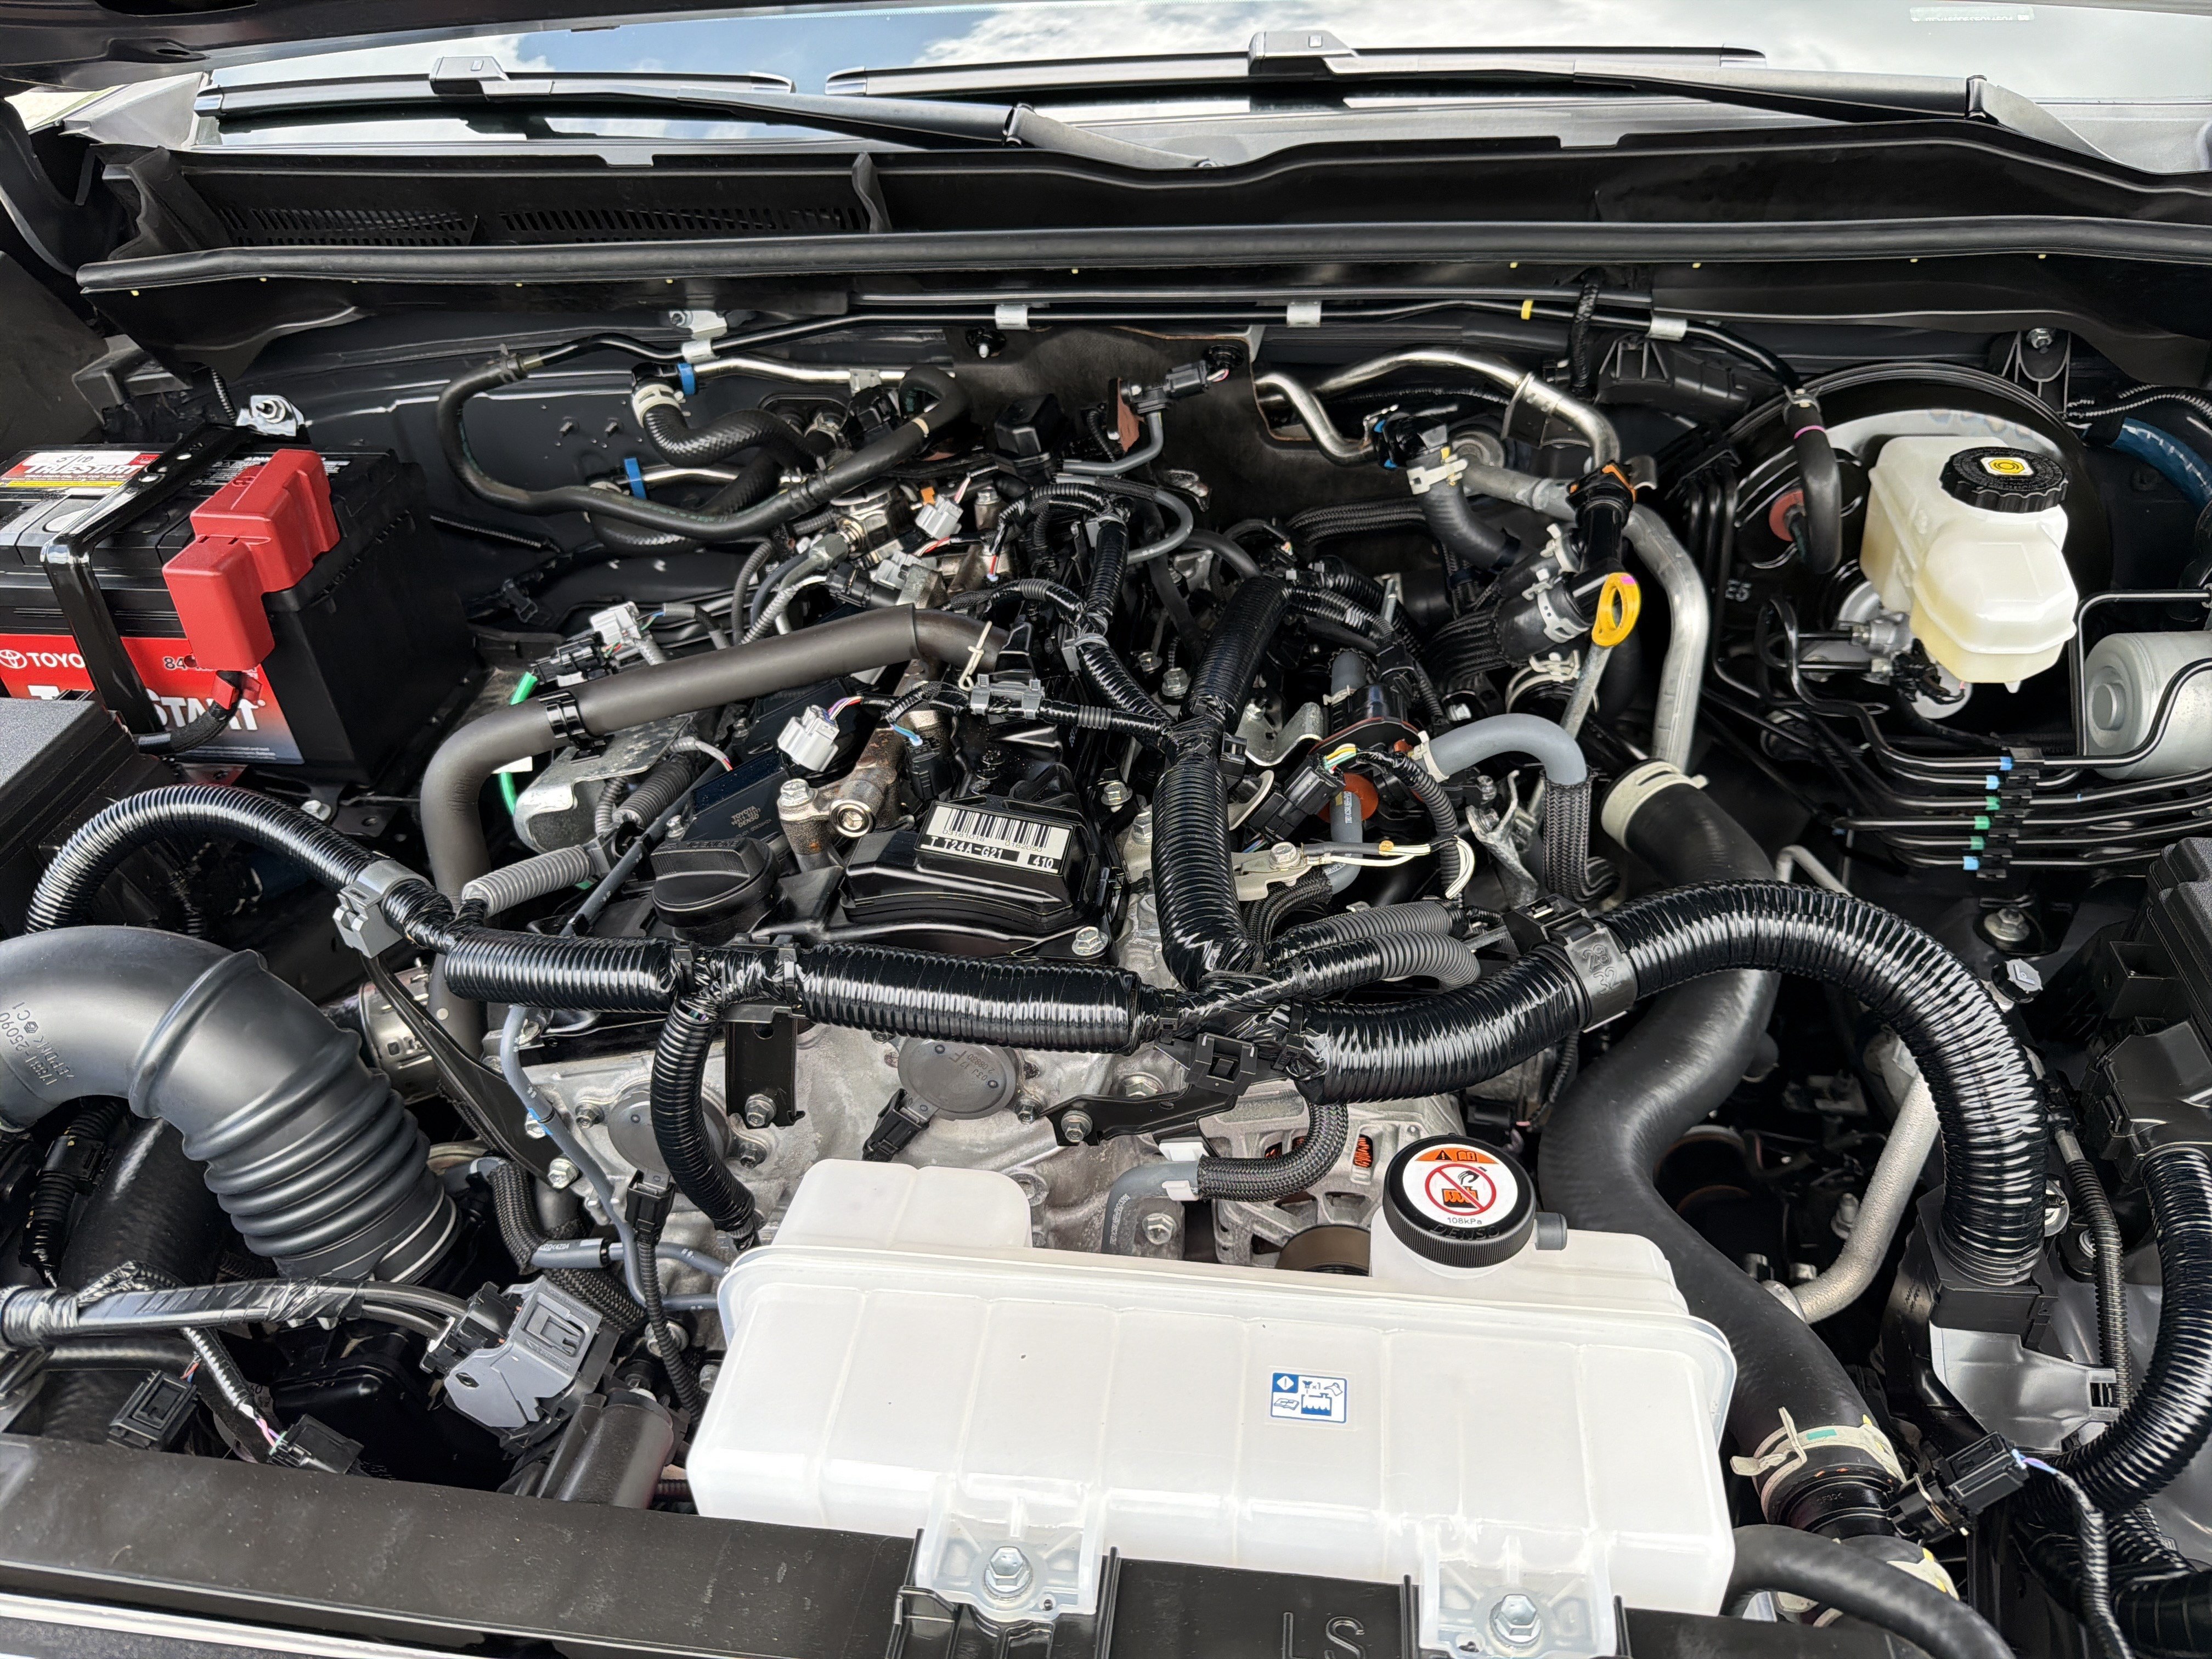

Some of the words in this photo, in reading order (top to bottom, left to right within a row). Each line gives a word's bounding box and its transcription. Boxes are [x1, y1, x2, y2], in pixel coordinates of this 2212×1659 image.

[24, 464, 146, 474] TRUESTART
[26, 652, 85, 668] TOYO
[731, 805, 757, 820] TOYOTA
[738, 814, 759, 828] DENSO
[944, 839, 1003, 859] T24A-G21
[1005, 840, 1043, 853] 0182050
[1032, 855, 1054, 869] 410
[1582, 944, 1612, 973] 28
[1593, 966, 1622, 994] 32
[949, 1050, 967, 1063] F
[1447, 1217, 1482, 1225] 108kPa
[1430, 1224, 1500, 1241] DENSO
